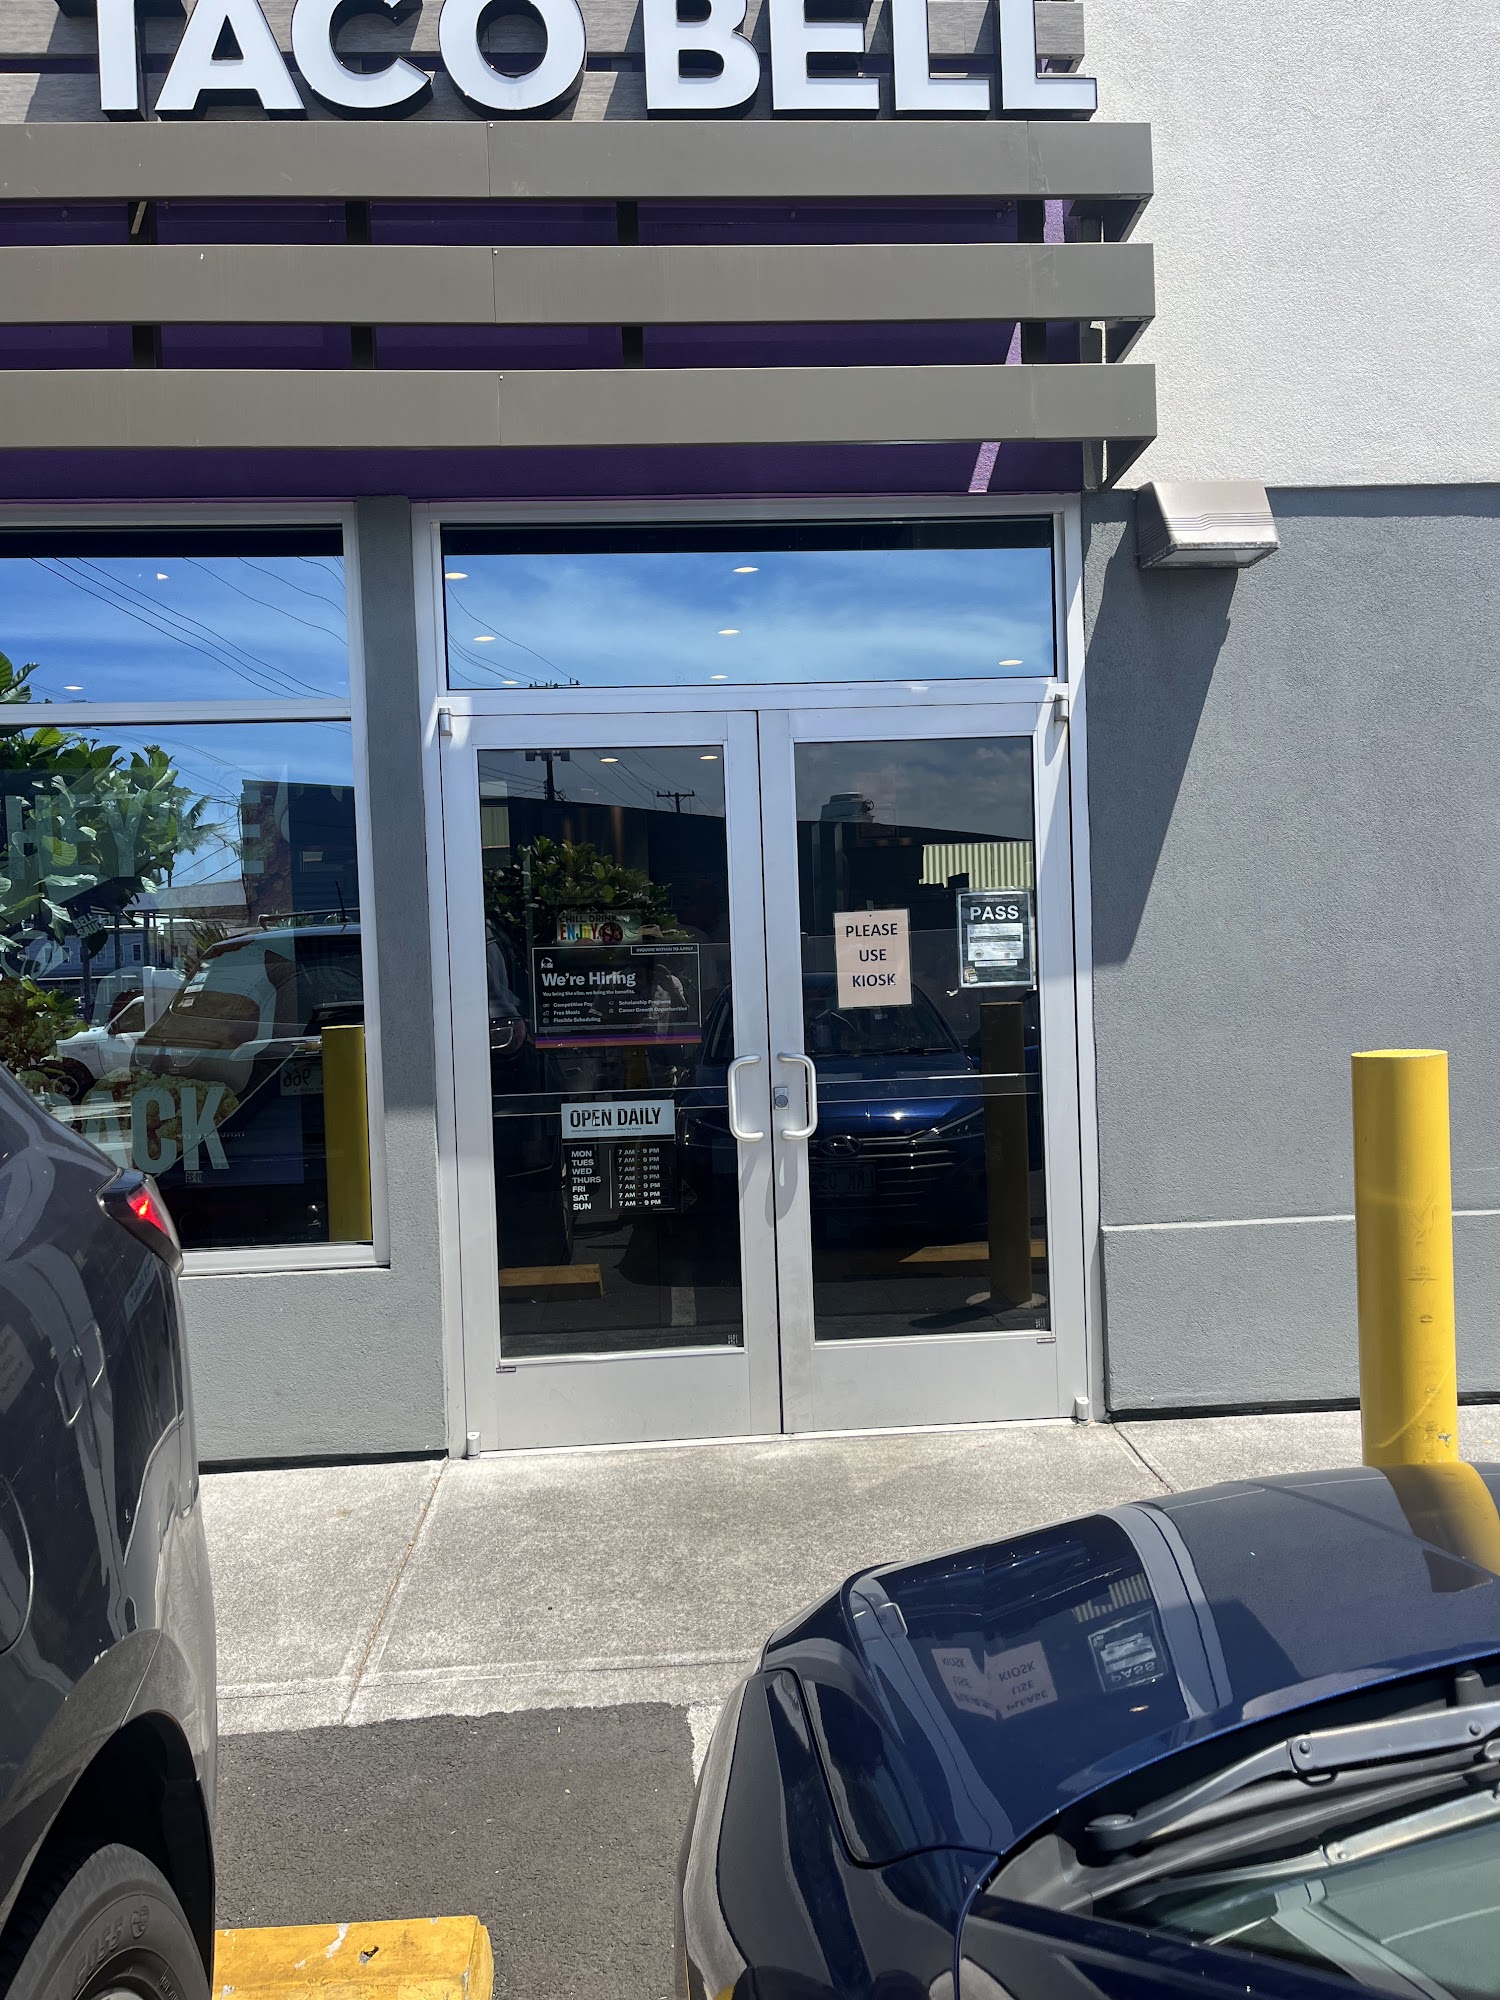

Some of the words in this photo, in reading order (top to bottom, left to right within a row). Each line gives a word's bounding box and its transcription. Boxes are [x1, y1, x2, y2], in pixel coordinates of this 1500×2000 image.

[640, 0, 1098, 111] BELL
[970, 905, 1019, 921] PASS
[845, 923, 898, 938] PLEASE
[859, 949, 887, 962] USE
[541, 972, 585, 987] We're
[588, 971, 637, 987] Hiring
[852, 973, 896, 987] KIOSK
[570, 1108, 612, 1127] OPEN
[617, 1107, 661, 1125] DAILY
[571, 1150, 592, 1158] MON
[573, 1194, 589, 1202] SAT
